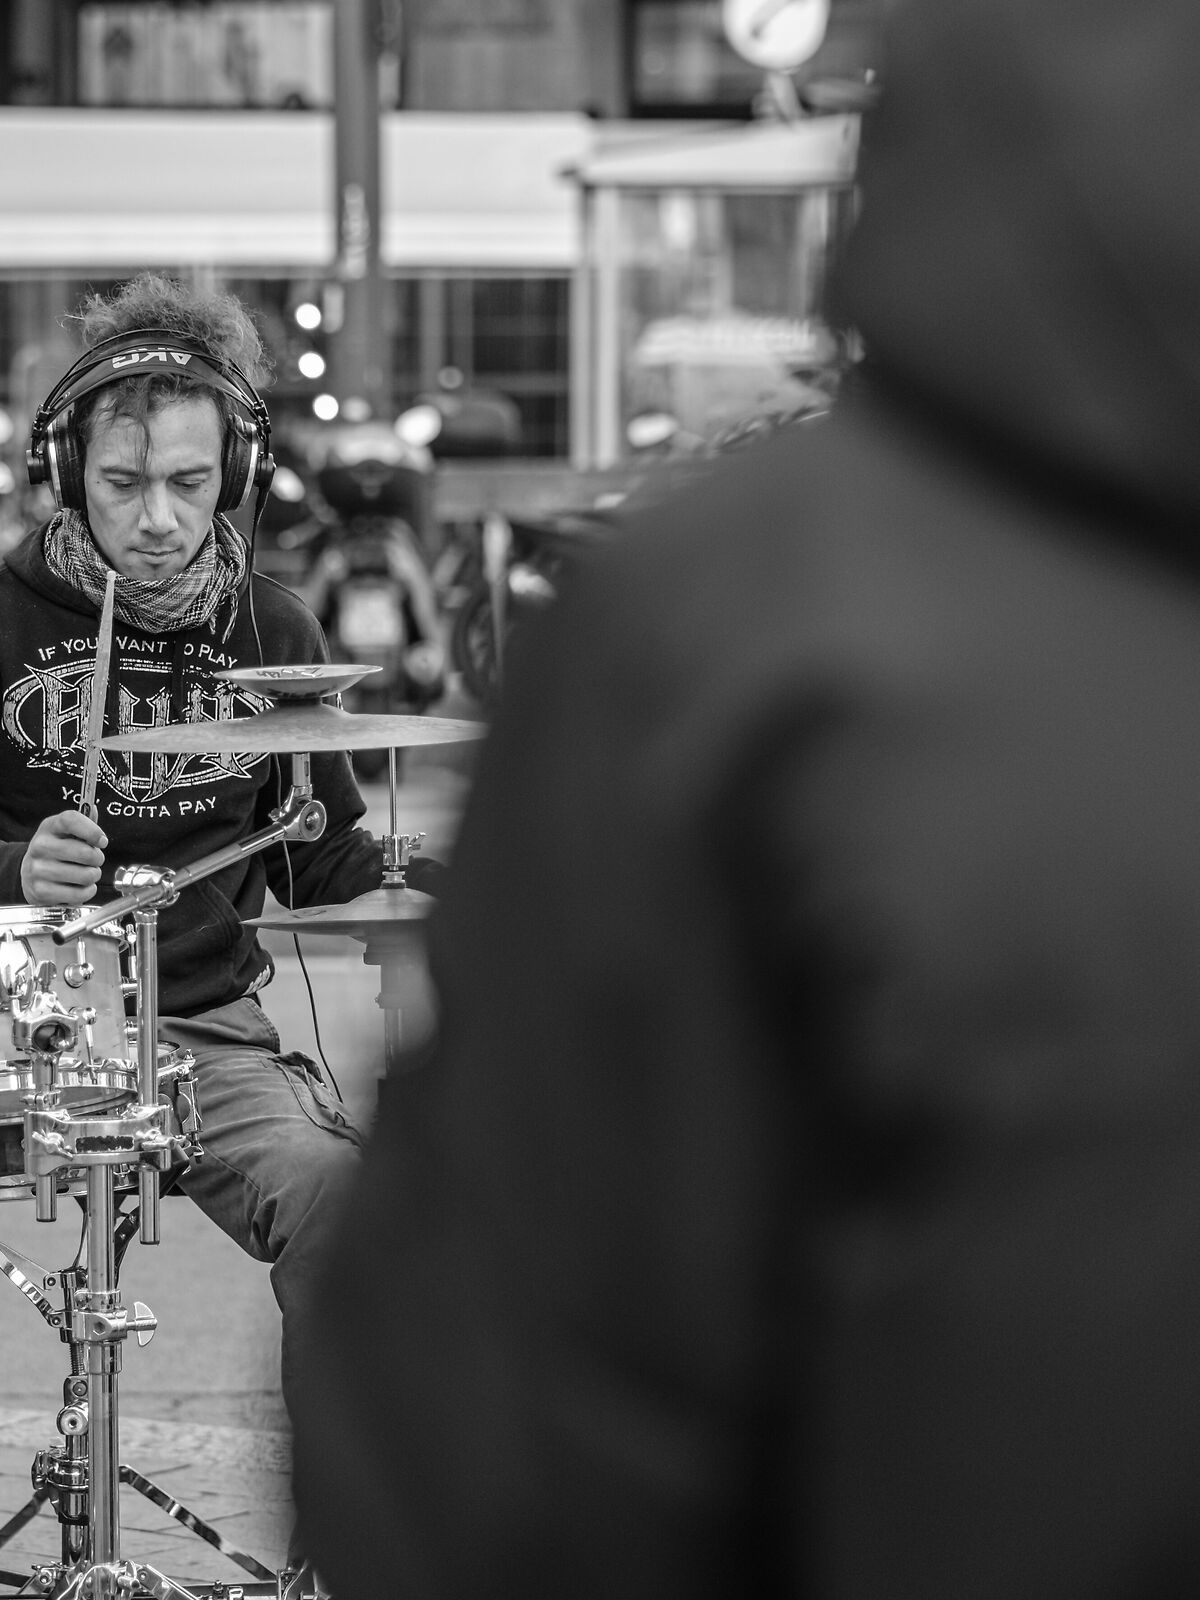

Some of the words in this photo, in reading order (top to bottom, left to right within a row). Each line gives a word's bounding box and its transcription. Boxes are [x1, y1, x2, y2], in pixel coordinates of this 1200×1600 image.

[112, 347, 192, 369] AKG
[38, 646, 56, 661] IF
[61, 636, 99, 654] YOU
[198, 643, 238, 669] PLAY
[62, 786, 100, 804] YO
[106, 801, 171, 818] GOTTA
[178, 796, 216, 816] PAY
